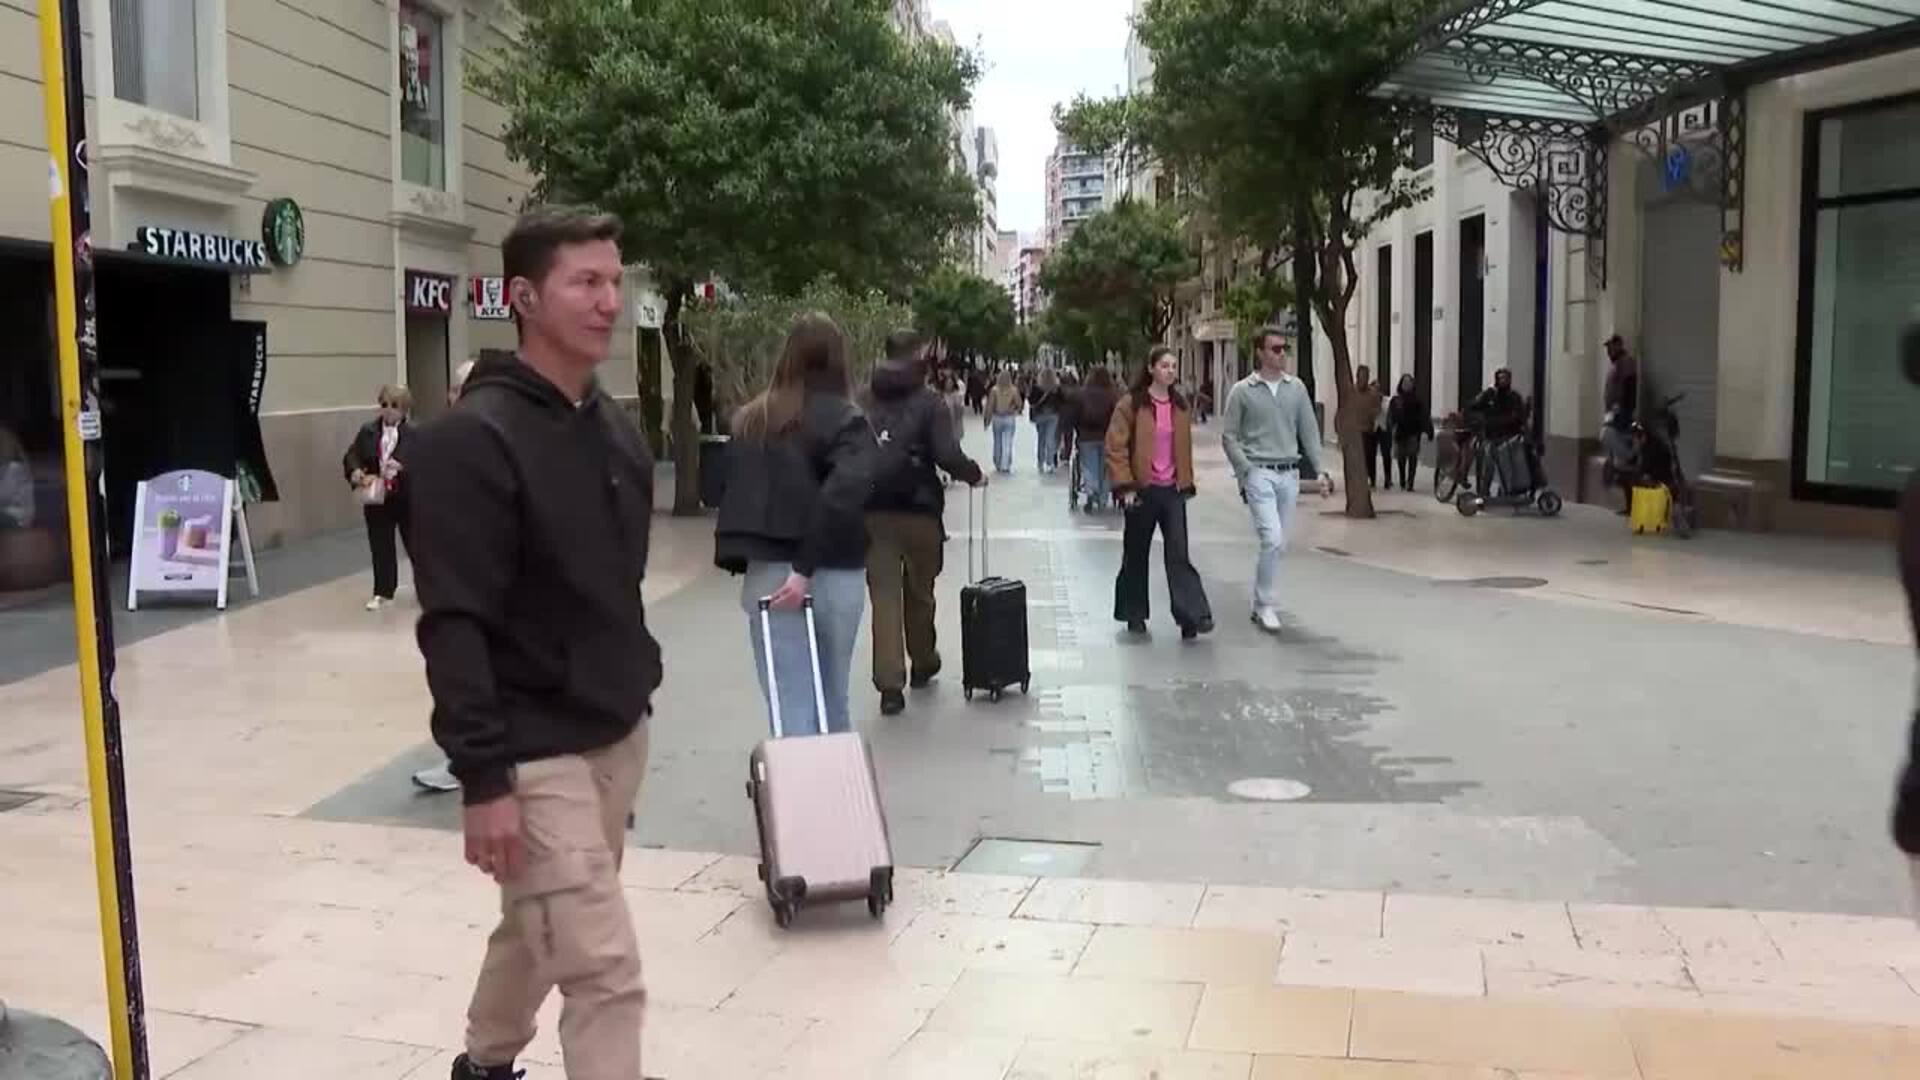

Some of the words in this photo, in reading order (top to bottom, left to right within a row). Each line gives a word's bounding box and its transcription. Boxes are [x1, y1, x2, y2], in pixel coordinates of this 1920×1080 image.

[146, 227, 266, 266] STARBUCKS
[413, 277, 450, 309] KFC
[481, 307, 505, 317] KFC
